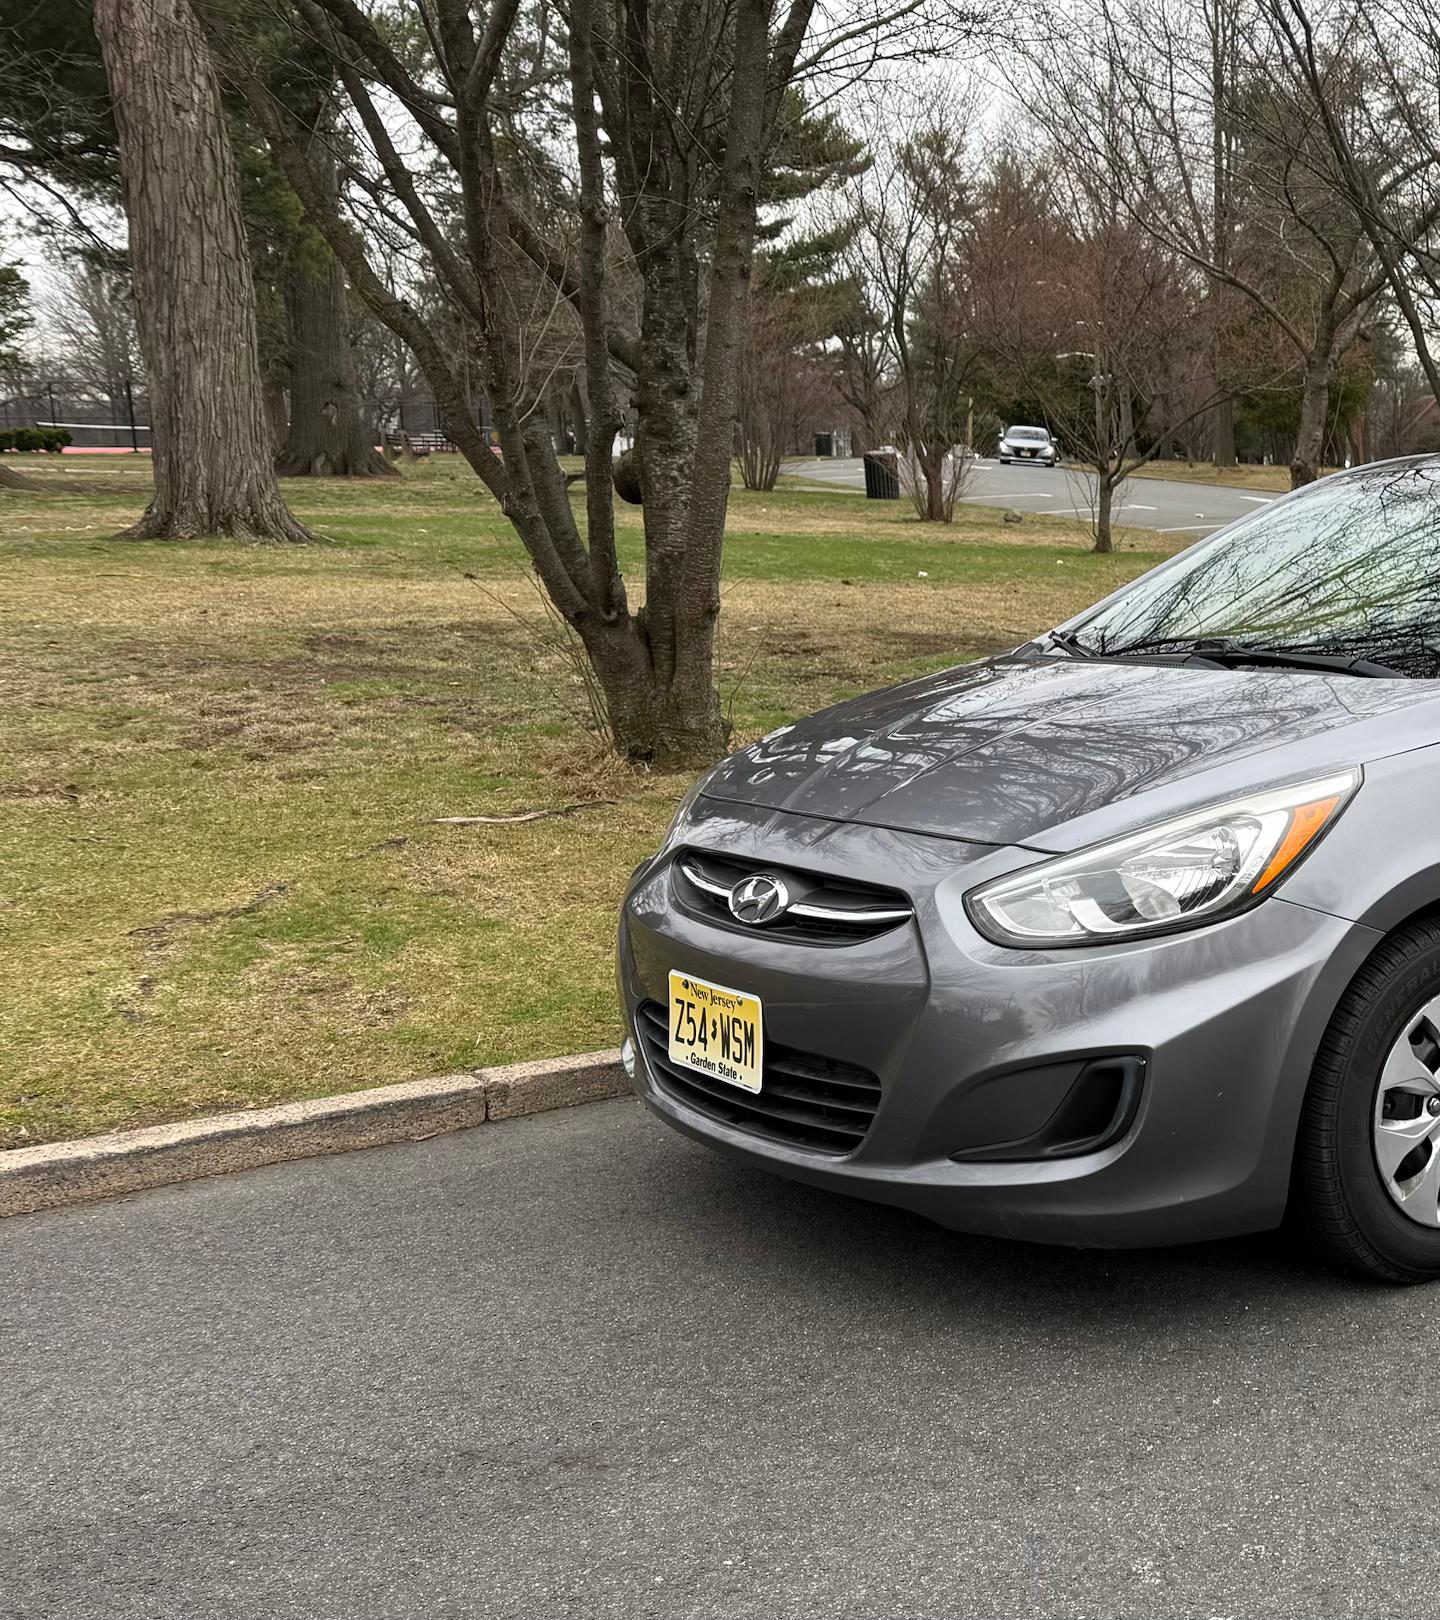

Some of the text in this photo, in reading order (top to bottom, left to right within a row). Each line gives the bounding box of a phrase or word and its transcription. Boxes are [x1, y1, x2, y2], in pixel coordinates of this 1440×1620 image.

[690, 982, 736, 1013] New Jersey
[675, 998, 755, 1069] Z54 WSM
[690, 1052, 737, 1080] Garden State
